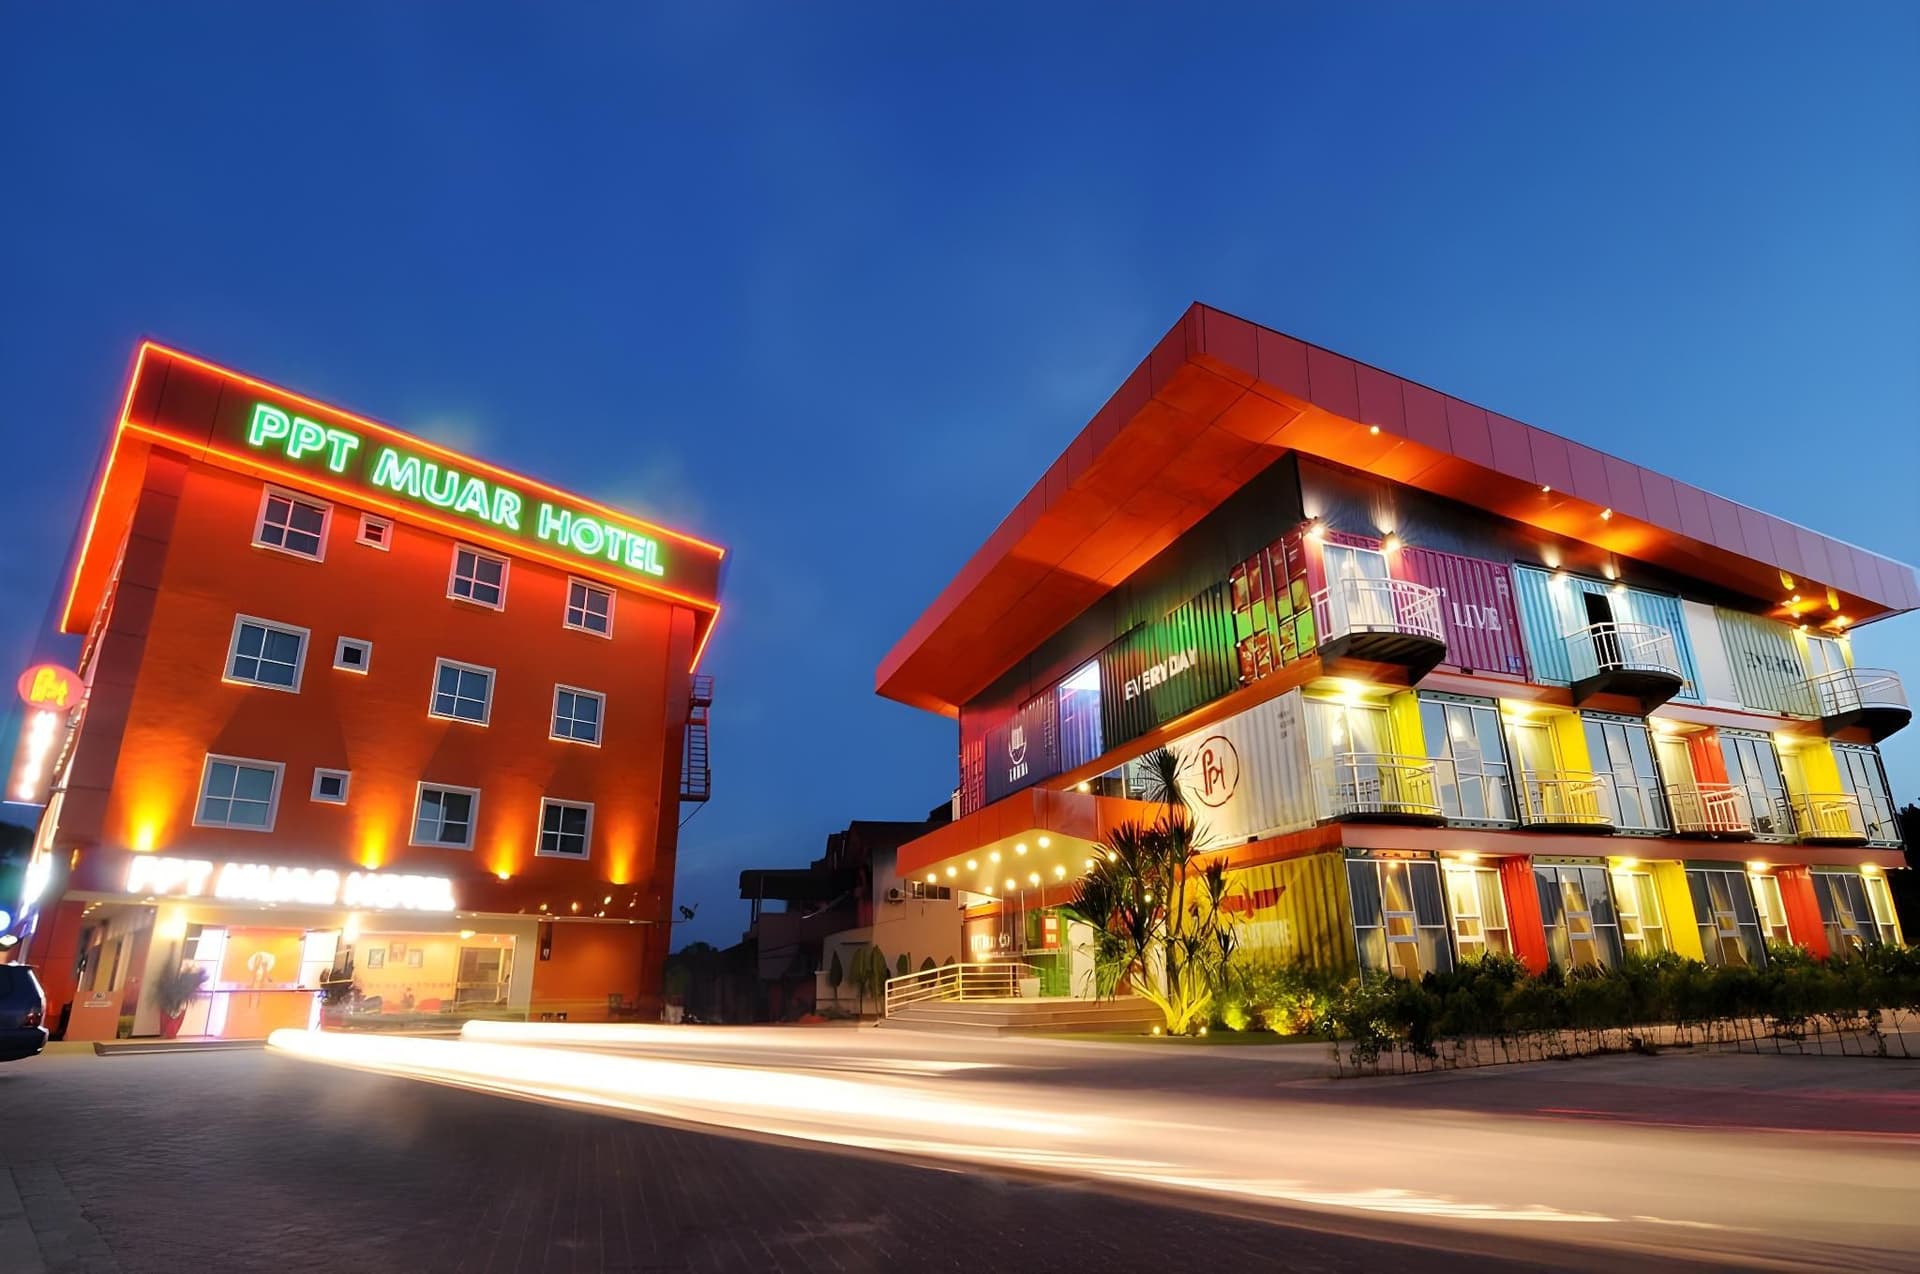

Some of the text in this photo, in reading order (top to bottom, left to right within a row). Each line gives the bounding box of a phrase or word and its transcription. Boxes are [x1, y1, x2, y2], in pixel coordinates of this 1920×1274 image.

[248, 403, 664, 576] PPT MUAR HOTEL
[1125, 648, 1197, 700] EVERYDAY
